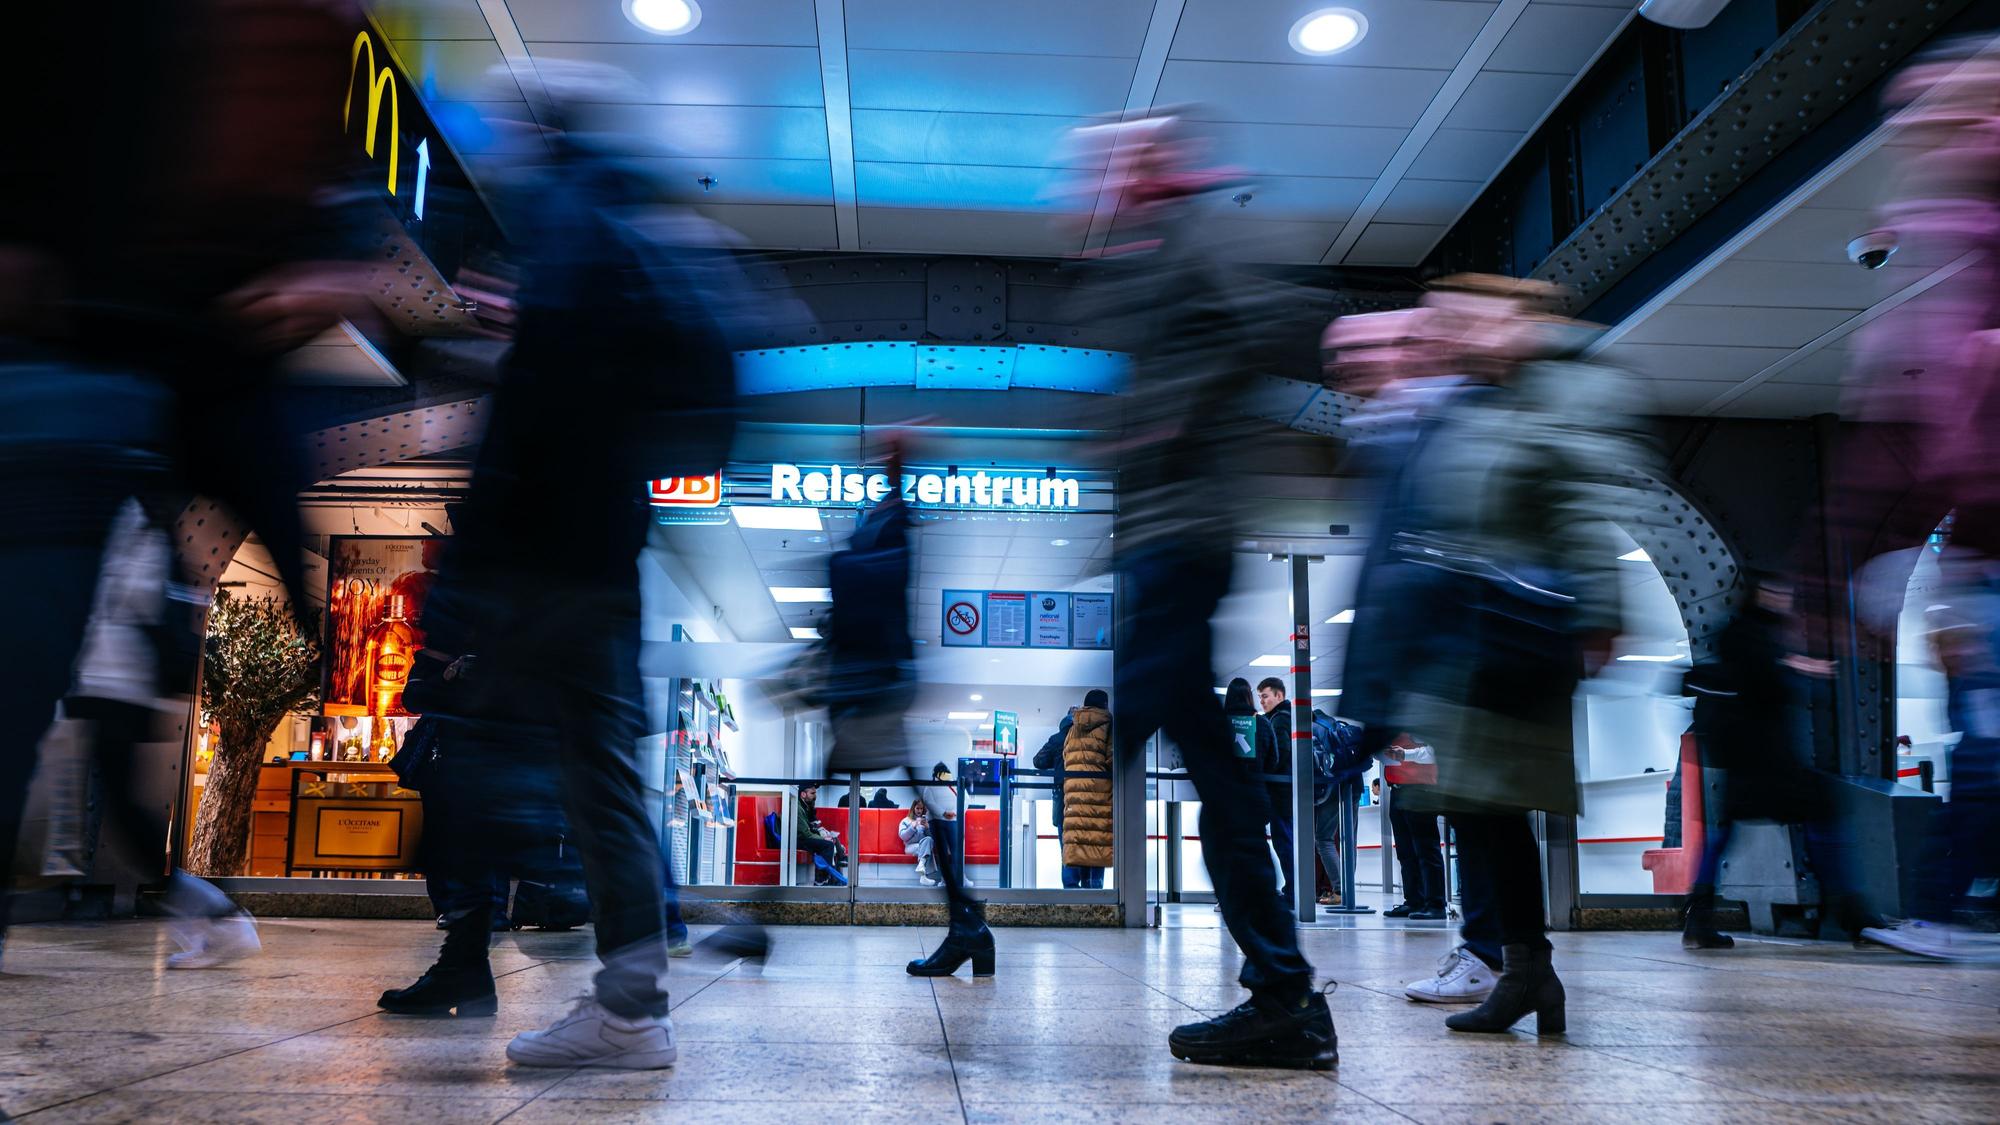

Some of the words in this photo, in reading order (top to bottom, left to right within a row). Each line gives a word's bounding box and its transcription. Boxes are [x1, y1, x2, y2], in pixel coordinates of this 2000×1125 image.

[771, 463, 1079, 507] Reisezentrum
[375, 566, 387, 575] Of
[342, 578, 380, 600] JOY
